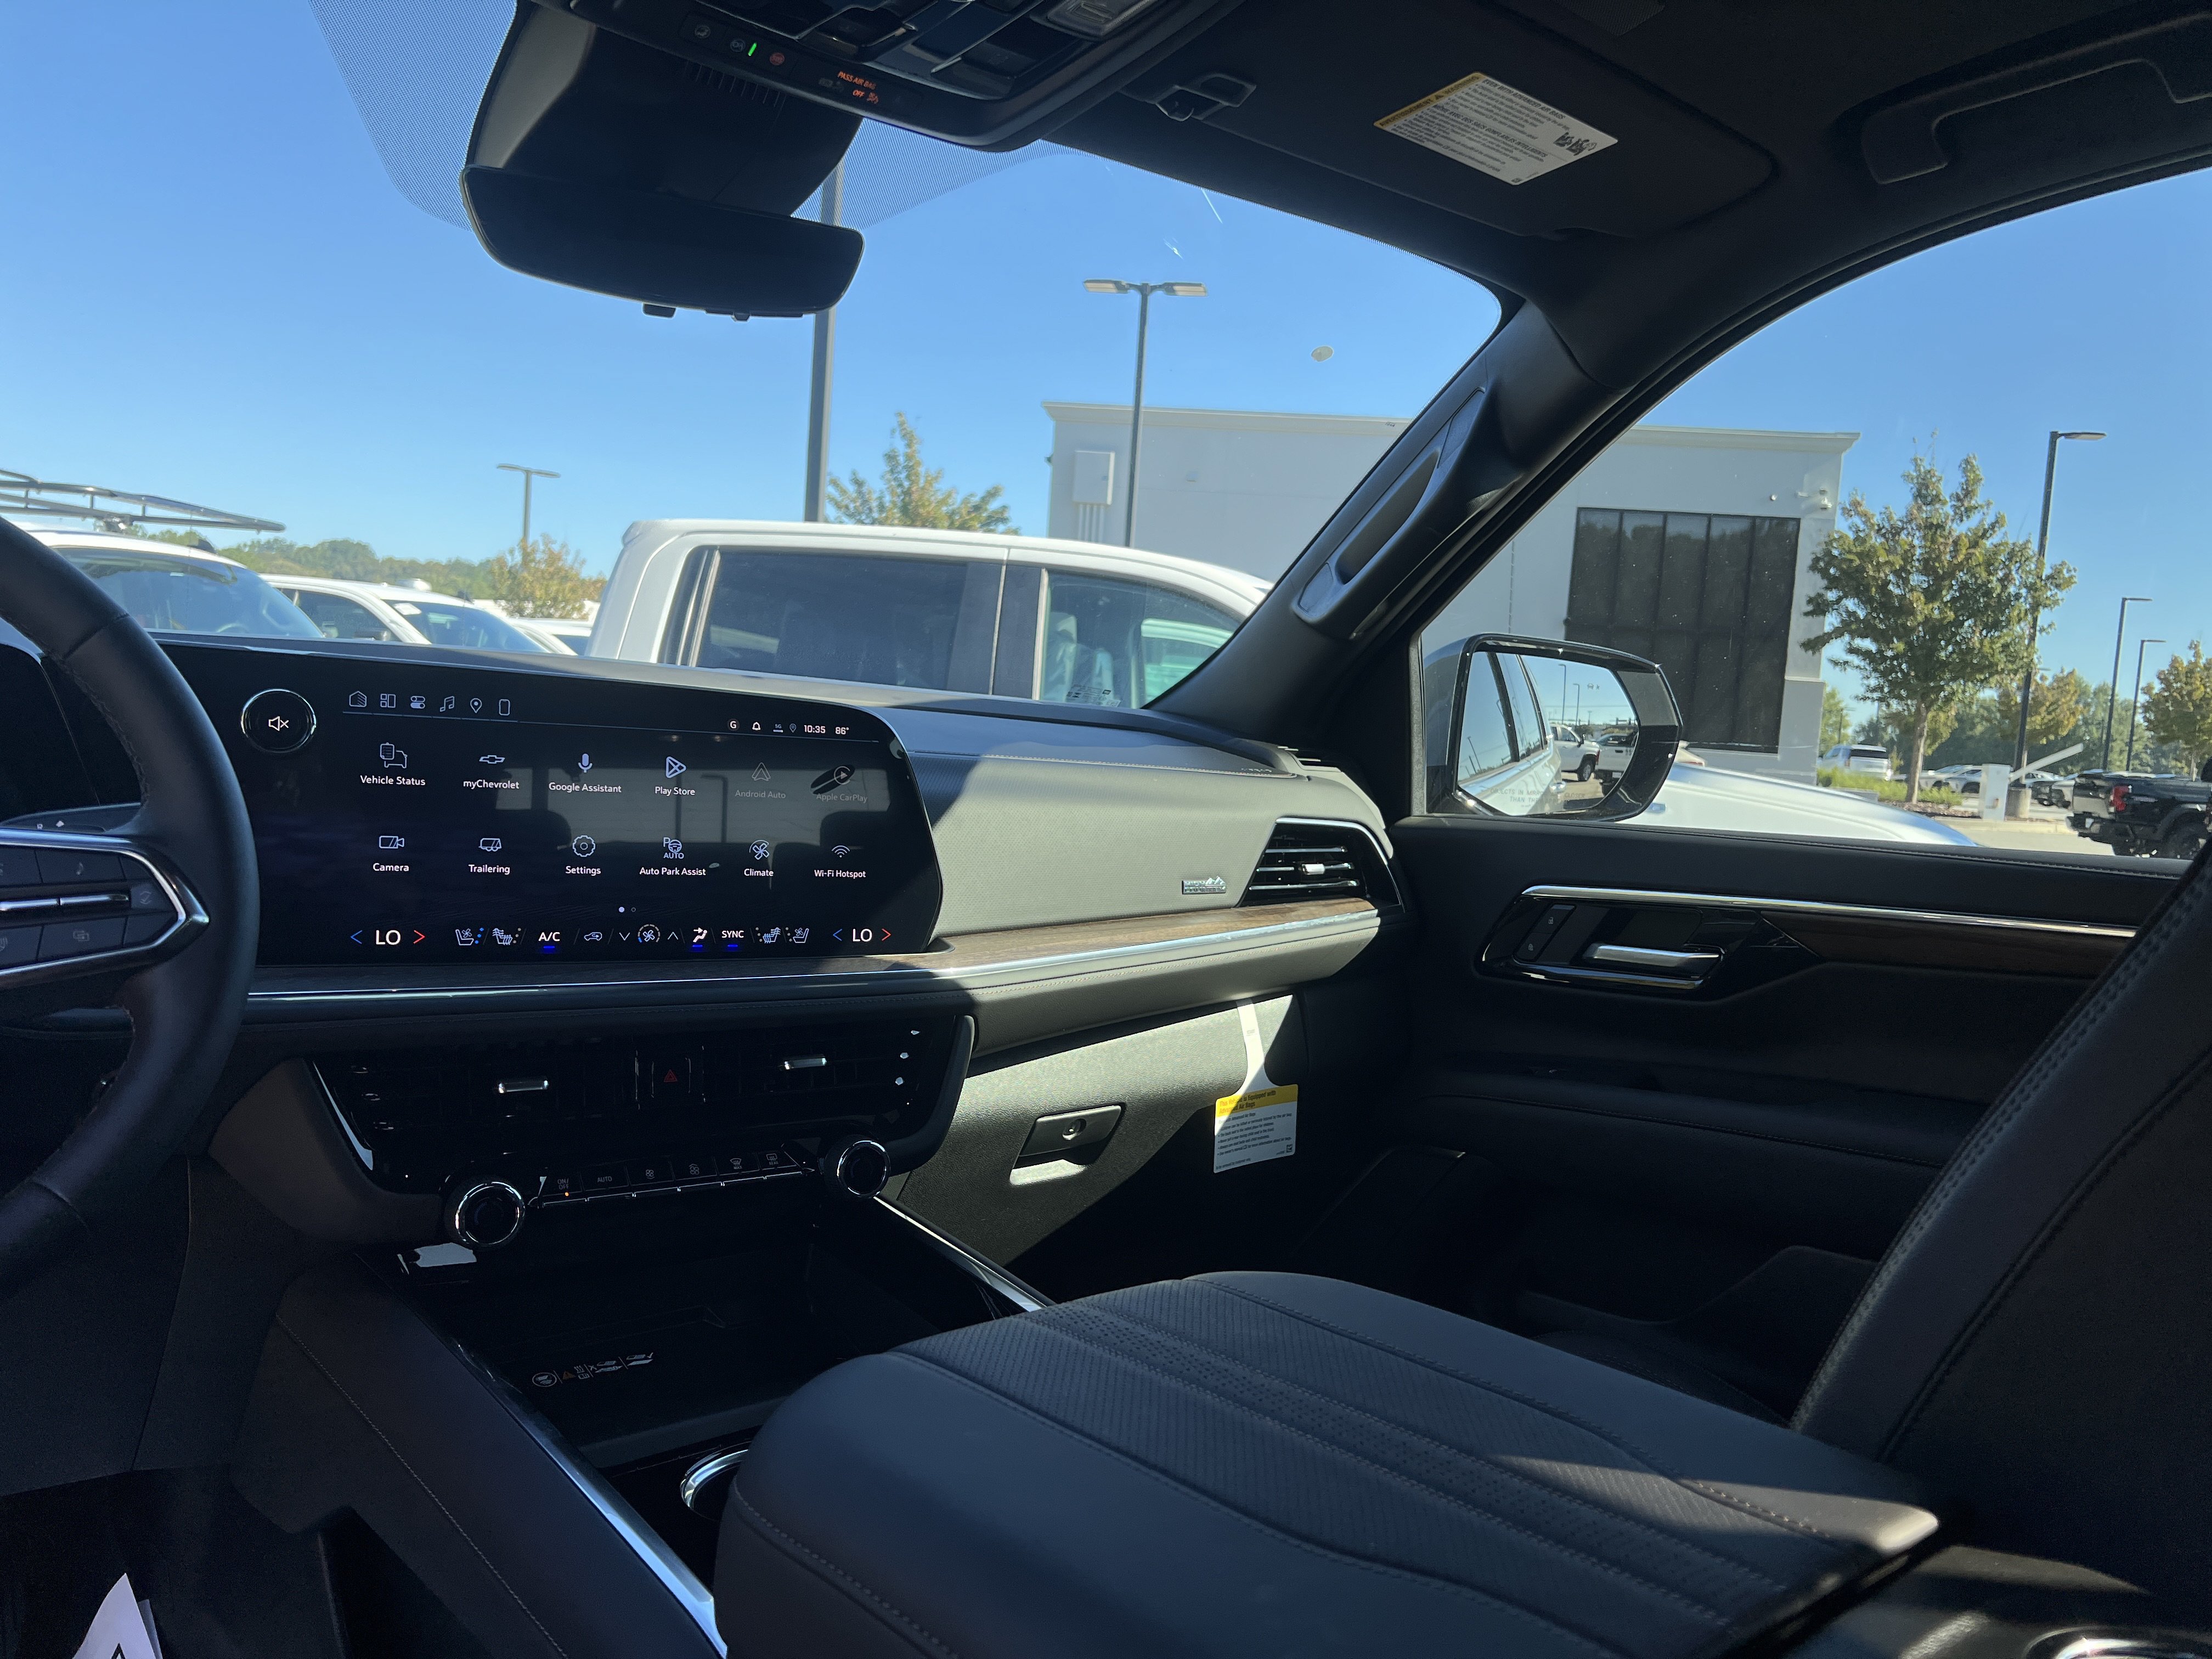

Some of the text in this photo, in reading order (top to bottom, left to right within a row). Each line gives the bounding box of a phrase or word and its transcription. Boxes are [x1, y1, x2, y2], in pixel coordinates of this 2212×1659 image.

[838, 71, 854, 82] PASS
[853, 77, 865, 86] AIR
[360, 775, 425, 785] Vehicle Status
[464, 780, 519, 789] myChevrolet
[549, 782, 621, 793] Google Assistant
[655, 787, 672, 796] Play
[816, 793, 867, 803] Apple CarPlay
[373, 863, 409, 871] Camera
[469, 865, 510, 874] Trailering
[566, 866, 601, 876] Settings
[836, 870, 866, 879] Hotspot
[376, 930, 400, 945] LO
[539, 932, 560, 941] A/C
[853, 929, 872, 941] LO
